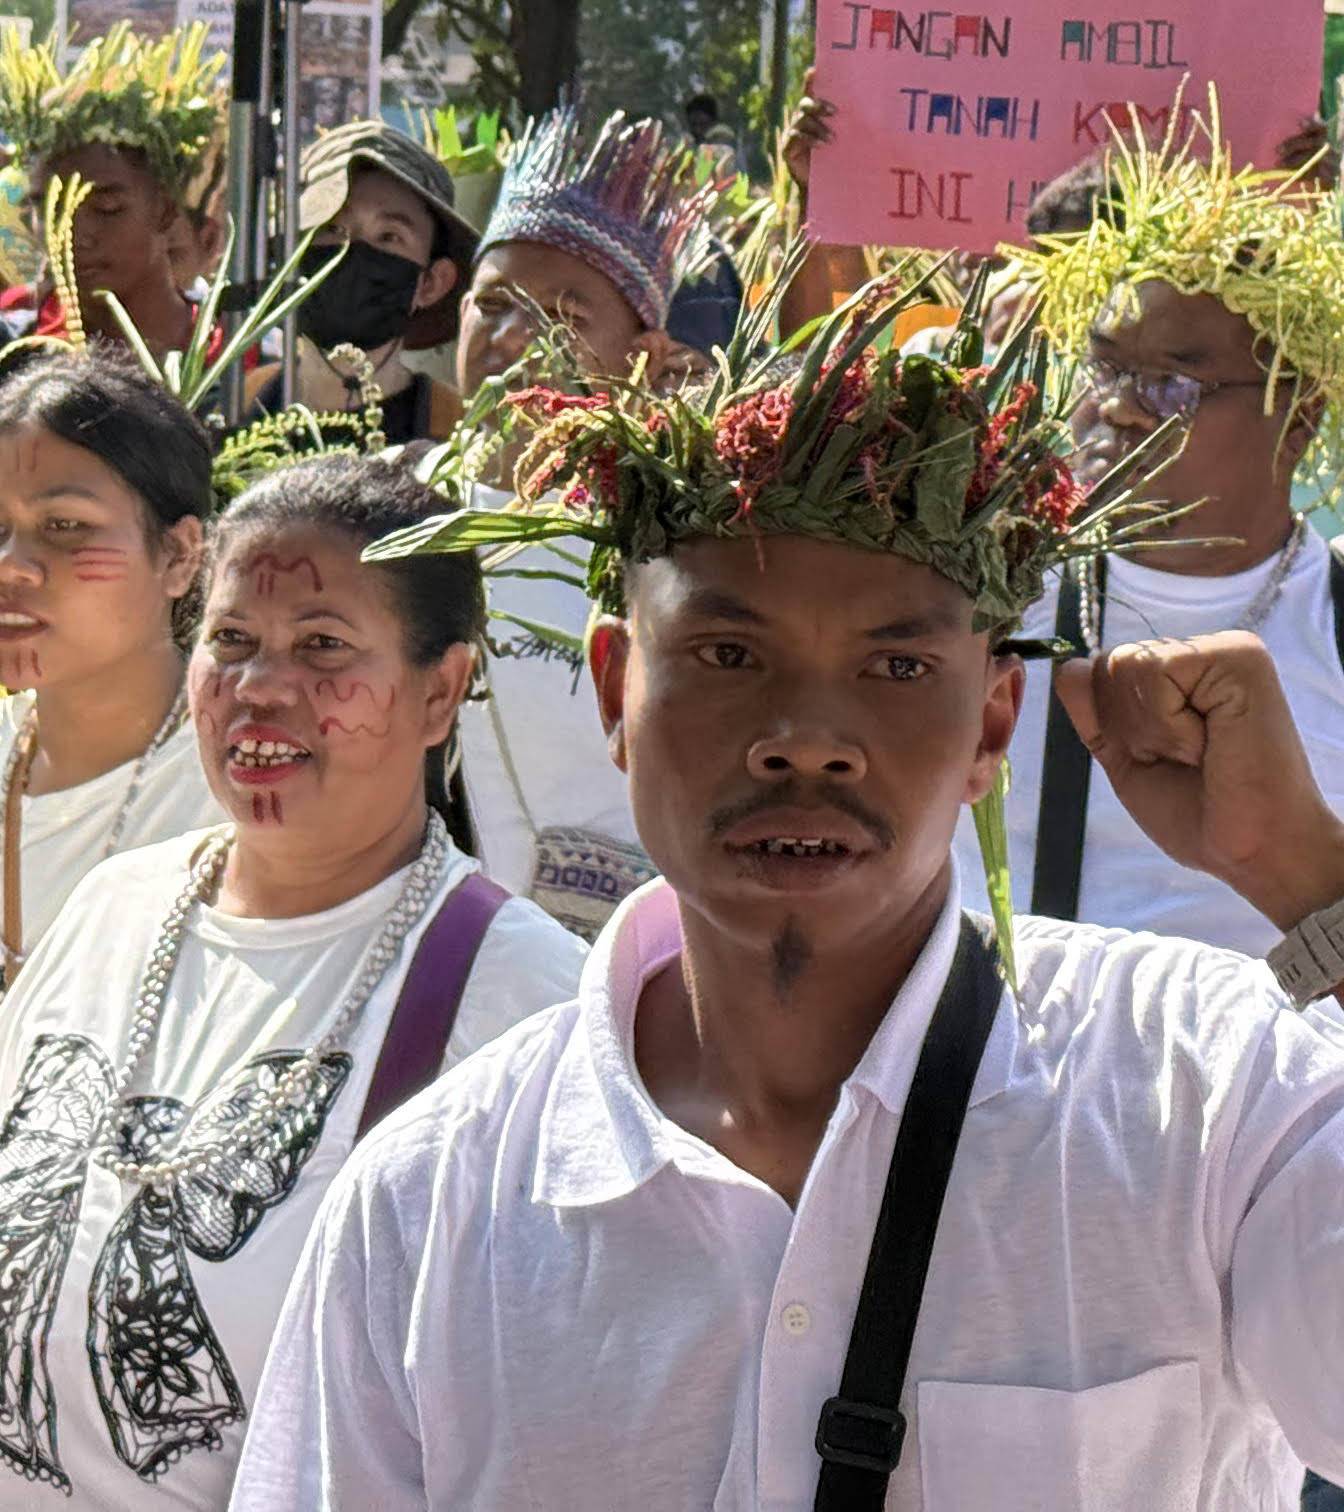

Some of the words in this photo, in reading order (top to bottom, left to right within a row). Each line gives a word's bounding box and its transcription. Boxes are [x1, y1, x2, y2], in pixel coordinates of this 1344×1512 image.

[832, 2, 1011, 59] JANGAN
[1061, 19, 1187, 69] AMBIL
[900, 88, 1040, 140] TANAH
[888, 168, 973, 223] INI
[1006, 179, 1048, 222] H
